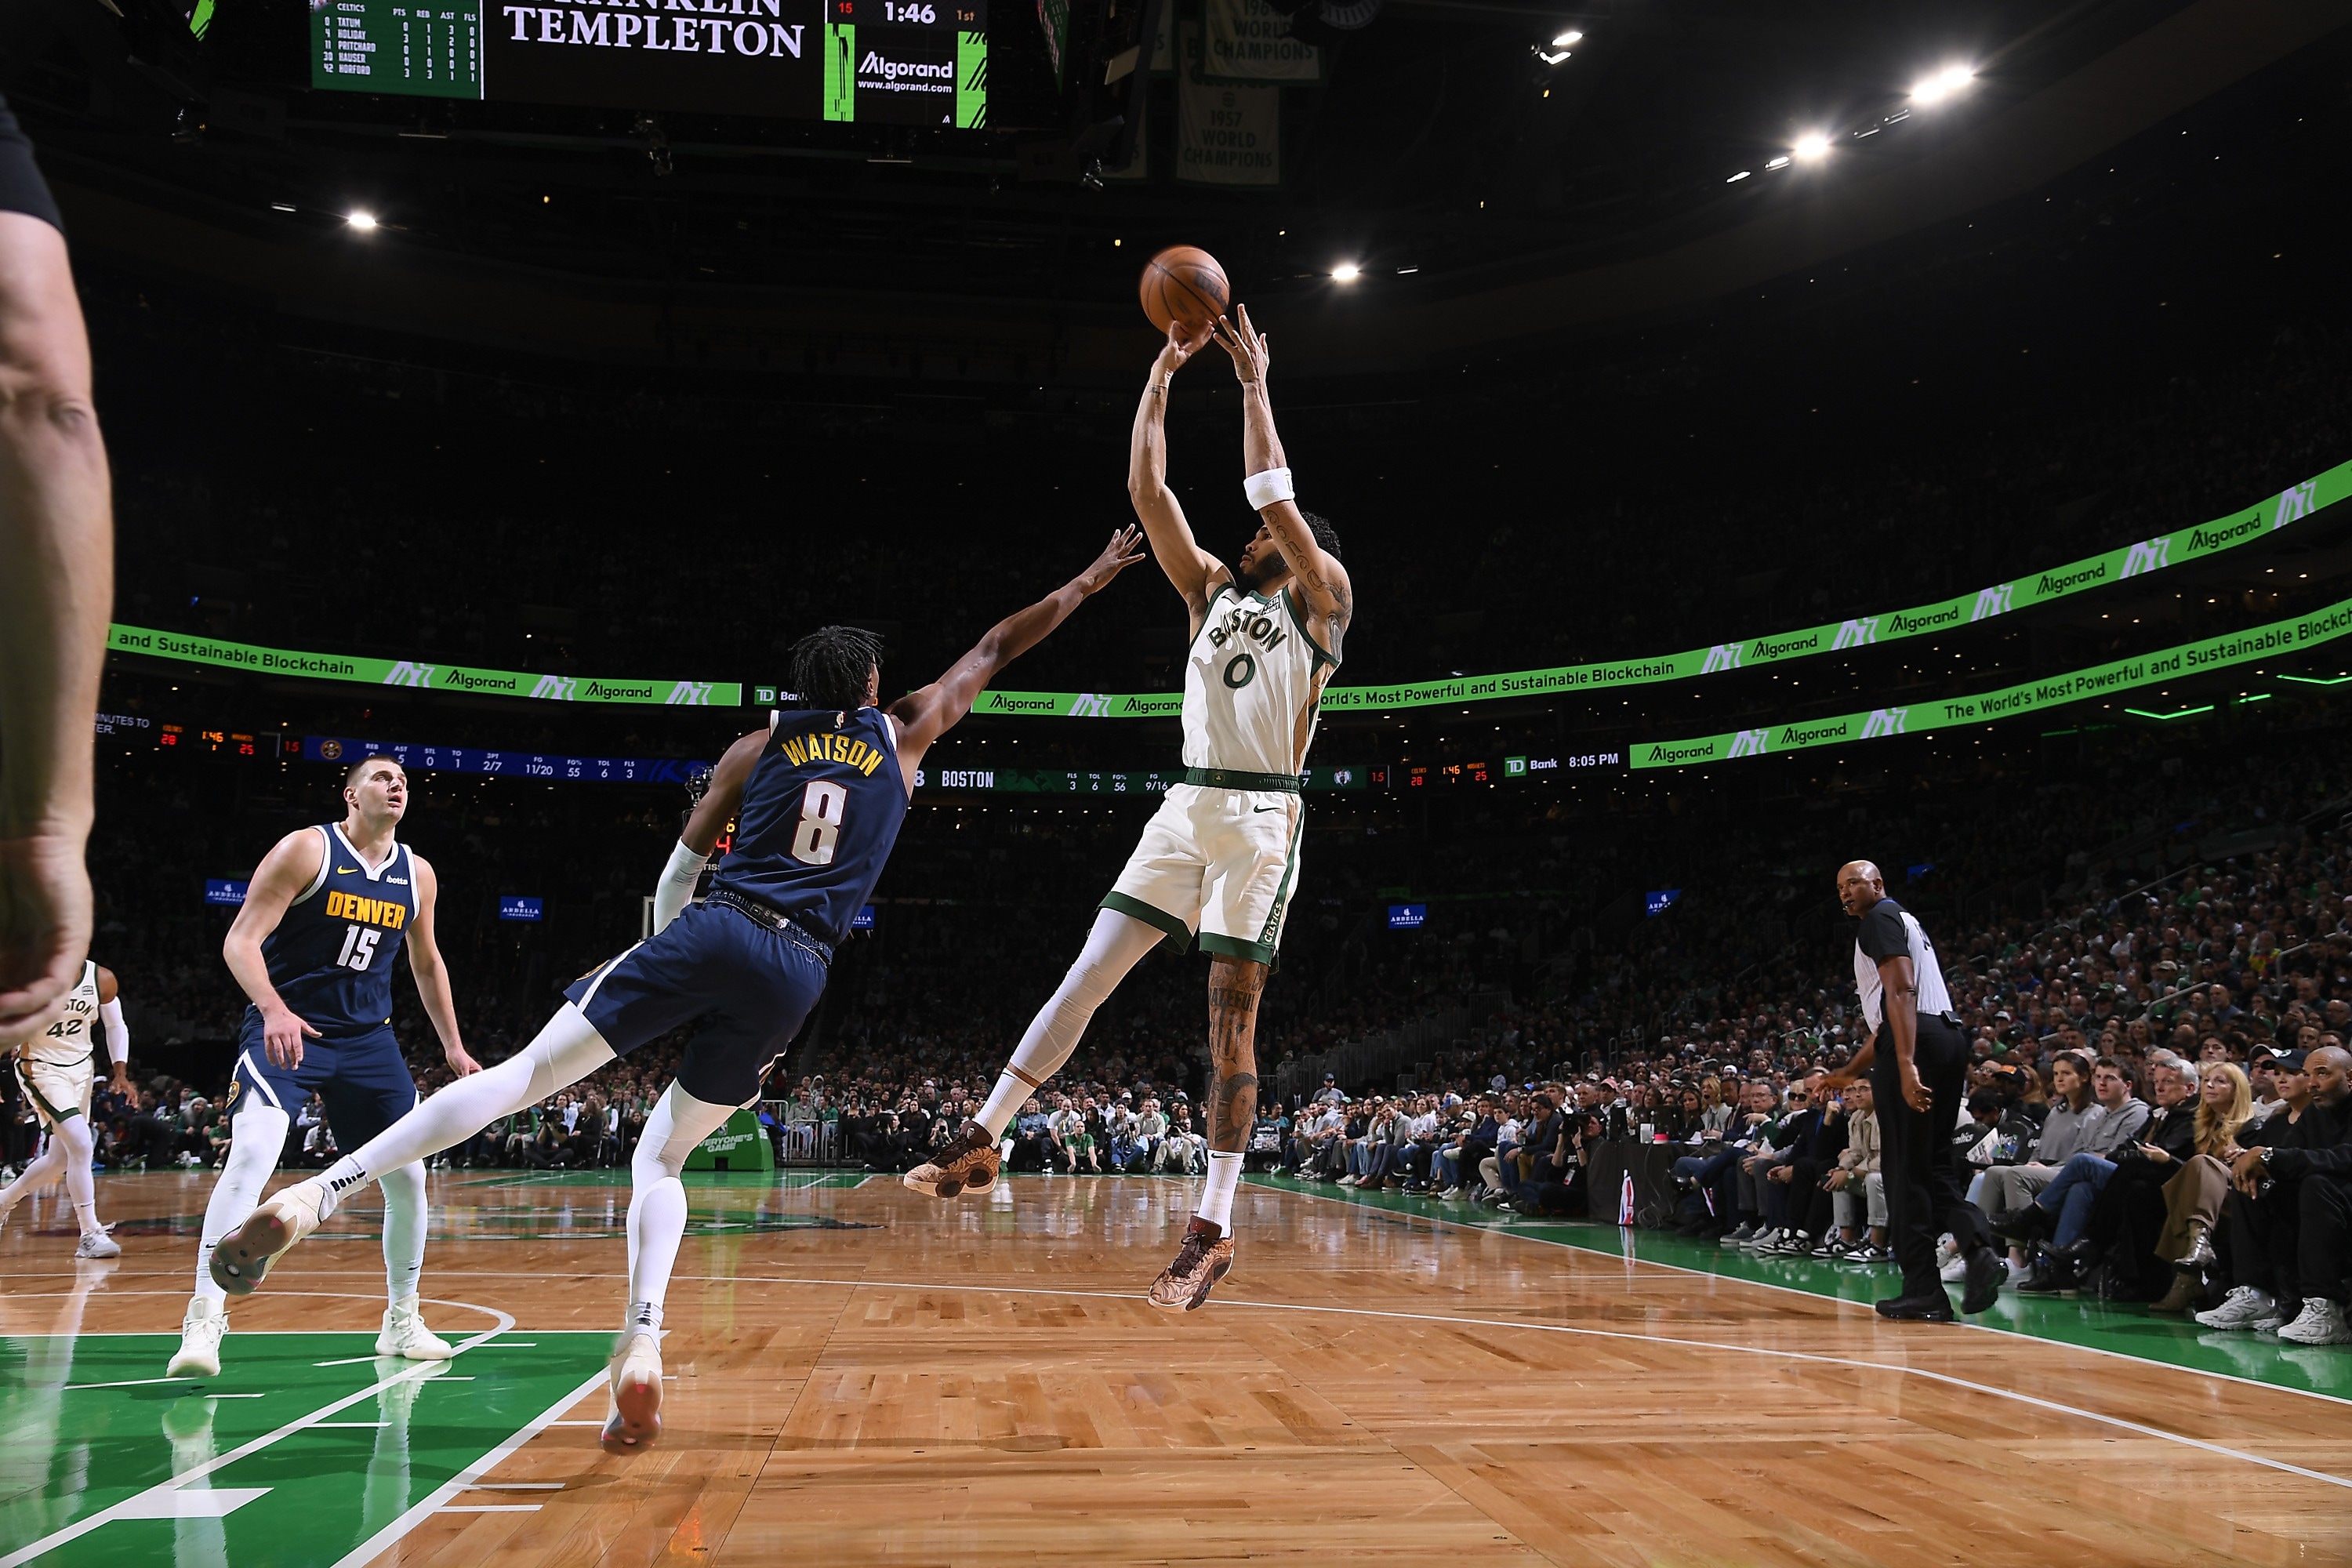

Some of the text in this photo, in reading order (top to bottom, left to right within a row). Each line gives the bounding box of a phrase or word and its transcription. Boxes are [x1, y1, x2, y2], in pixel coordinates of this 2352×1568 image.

[337, 3, 365, 13] CELTICS
[393, 8, 407, 16] PTS
[416, 9, 430, 18] REB
[838, 2, 853, 13] 15
[884, 2, 936, 24] 1:46
[956, 9, 975, 21] 1st
[1244, 0, 1280, 16] 196
[336, 17, 361, 28] TATUM
[403, 22, 408, 31] 0
[426, 23, 431, 33] 1
[448, 24, 455, 34] 3
[469, 26, 475, 36] 0
[503, 6, 805, 58] TEMPLETON
[1233, 20, 1293, 39] WORLD
[337, 29, 366, 40] HOLIDAY
[403, 34, 409, 43] 3
[426, 35, 431, 45] 1
[448, 37, 455, 46] 2
[470, 38, 475, 48] 0
[325, 40, 475, 60] 11 PRITCHARD 0 1 0 0
[1213, 38, 1314, 60] CHAMPIONS
[323, 51, 475, 71] 30 HAUSER 0 0 0 0
[858, 51, 953, 79] Algorand
[323, 63, 474, 82] 42 HORFORD 3 3 1 1
[858, 80, 953, 93] www.algorand.com
[1210, 110, 1243, 127] 1957
[1202, 129, 1258, 148] WORLD
[1184, 147, 1273, 168] CHAMPIONS
[2187, 513, 2261, 551] Algorand
[2036, 563, 2106, 595] Algorand
[1262, 595, 1280, 609] VISTA
[1888, 606, 1958, 633] Algorand
[119, 633, 151, 648] and
[158, 637, 257, 664] Sustainable
[263, 654, 354, 674] Blockchain
[1751, 634, 1818, 659] Algorand
[1222, 653, 1257, 688] 0
[1944, 608, 2352, 720] The World's Most Powerful and Sustainable Blockch
[445, 669, 516, 691] Algorand
[1319, 662, 1675, 706] orld's Most Powerful and Sustainable Blockchain
[584, 681, 652, 700] Algorand
[757, 689, 775, 702] TD
[989, 694, 1054, 711] Algorand
[96, 713, 151, 728] INUTES TO
[161, 734, 177, 745] 28
[1780, 723, 1846, 745] Algorand
[239, 744, 255, 755] 25
[285, 740, 299, 753] 15
[782, 733, 884, 777] WATSON
[1648, 742, 1714, 763] Algorand
[426, 757, 434, 767] 0
[456, 758, 460, 768] 1
[483, 760, 503, 771] 2/7
[526, 764, 554, 776] 11/20
[568, 768, 581, 778] 55
[601, 768, 608, 779] 6
[626, 769, 633, 779] 3
[1443, 764, 1460, 775] 1:46
[1506, 758, 1558, 773] TD Bank
[1569, 753, 1619, 768] 8:05 PM
[942, 770, 994, 788] BOSTON
[1302, 778, 1310, 787] 7
[1372, 771, 1385, 782] 15
[1411, 776, 1422, 786] 28
[1475, 771, 1487, 782] 25
[1069, 781, 1168, 792] 3 6 56 9/16
[790, 779, 850, 866] 8
[386, 875, 408, 885] ibotta
[325, 891, 406, 930] DENVER
[1264, 902, 1282, 942] CELTICS
[336, 924, 382, 971] 15
[47, 1019, 82, 1038] 42
[699, 1134, 753, 1147] VERYONE'S
[707, 1142, 736, 1152] GAME
